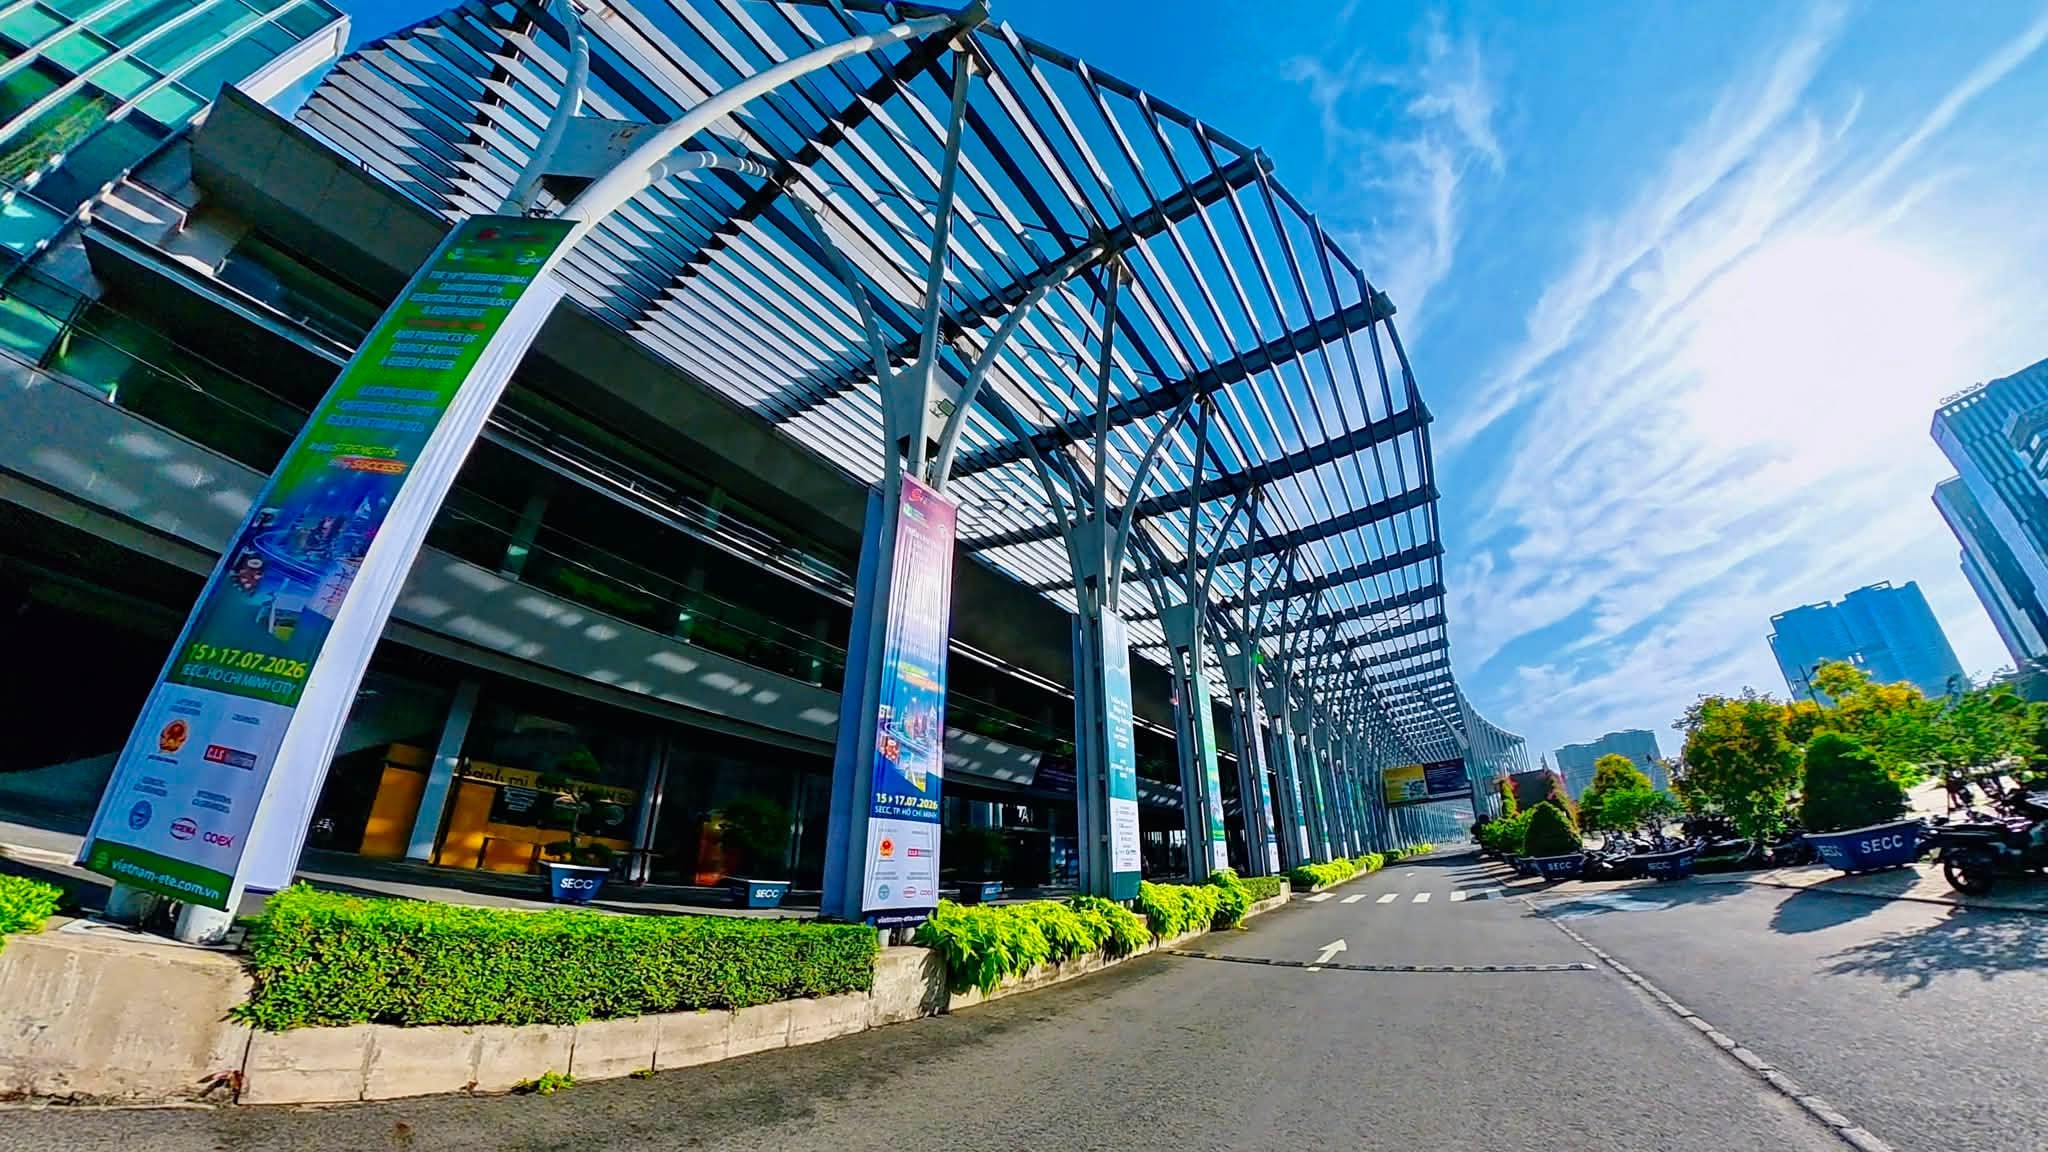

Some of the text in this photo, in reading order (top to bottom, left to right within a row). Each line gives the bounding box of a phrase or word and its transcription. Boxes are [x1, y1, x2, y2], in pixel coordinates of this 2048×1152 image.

[220, 647, 307, 679] 17.07.2026
[895, 795, 938, 810] 17.07.2026
[1861, 834, 1904, 854] SECC
[112, 858, 219, 899] vietnam-ete.com.vn
[560, 878, 594, 890] SECC
[755, 888, 779, 899] SECC
